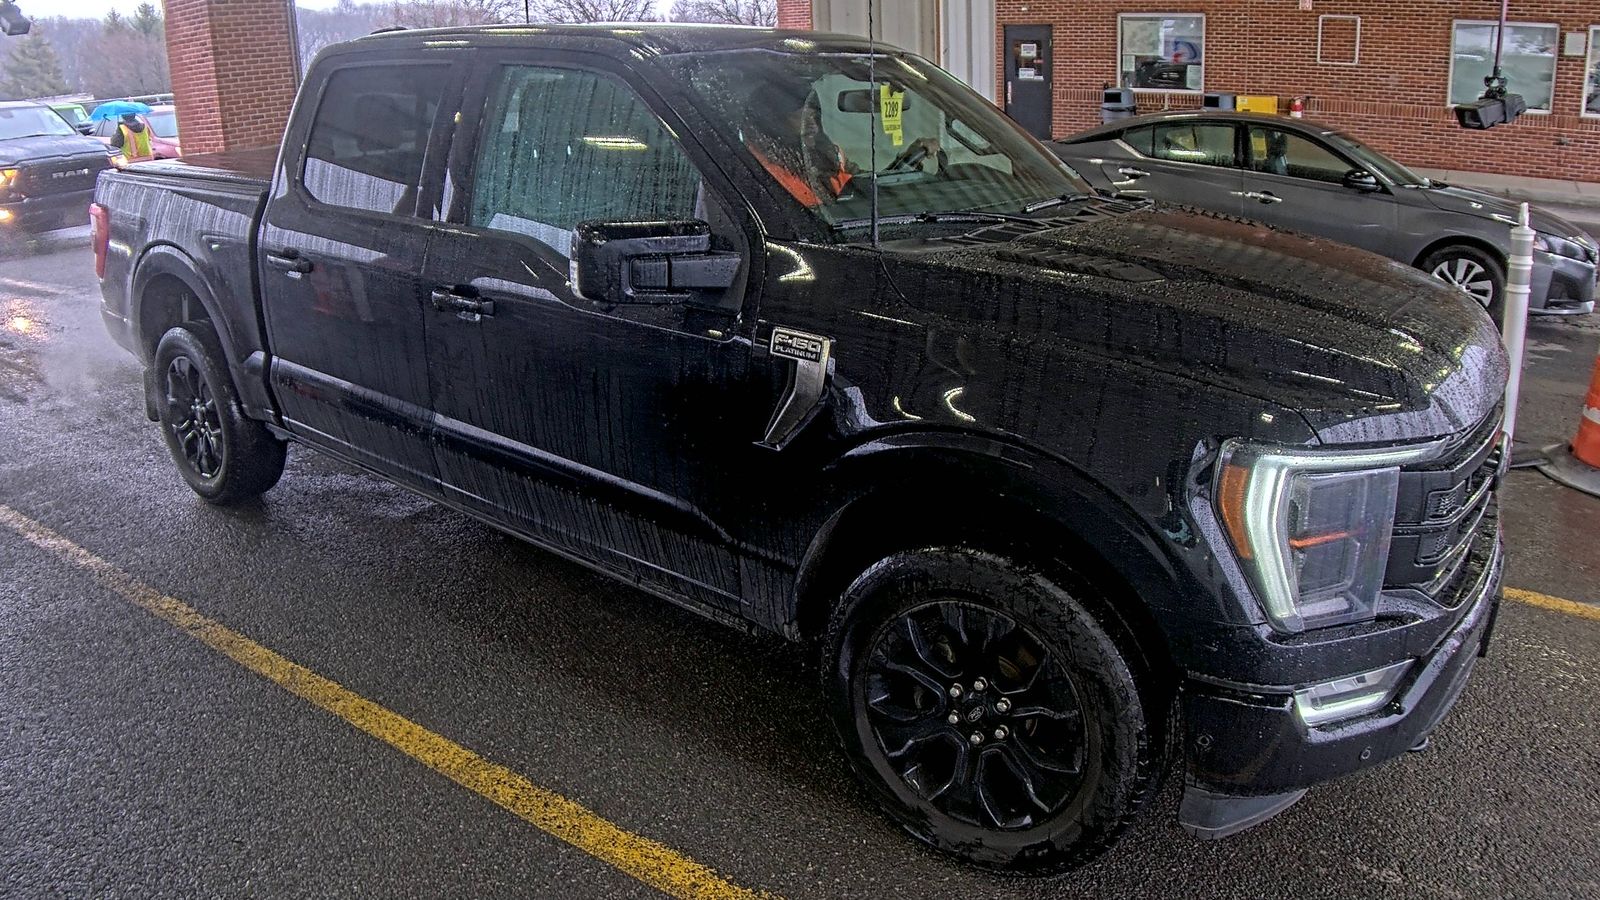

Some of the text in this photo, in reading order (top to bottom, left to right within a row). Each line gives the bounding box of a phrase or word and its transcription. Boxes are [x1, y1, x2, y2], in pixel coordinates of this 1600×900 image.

[884, 101, 899, 118] 2289
[52, 168, 89, 178] RAM
[774, 333, 821, 352] F-150
[775, 344, 817, 360] PLATINUM
